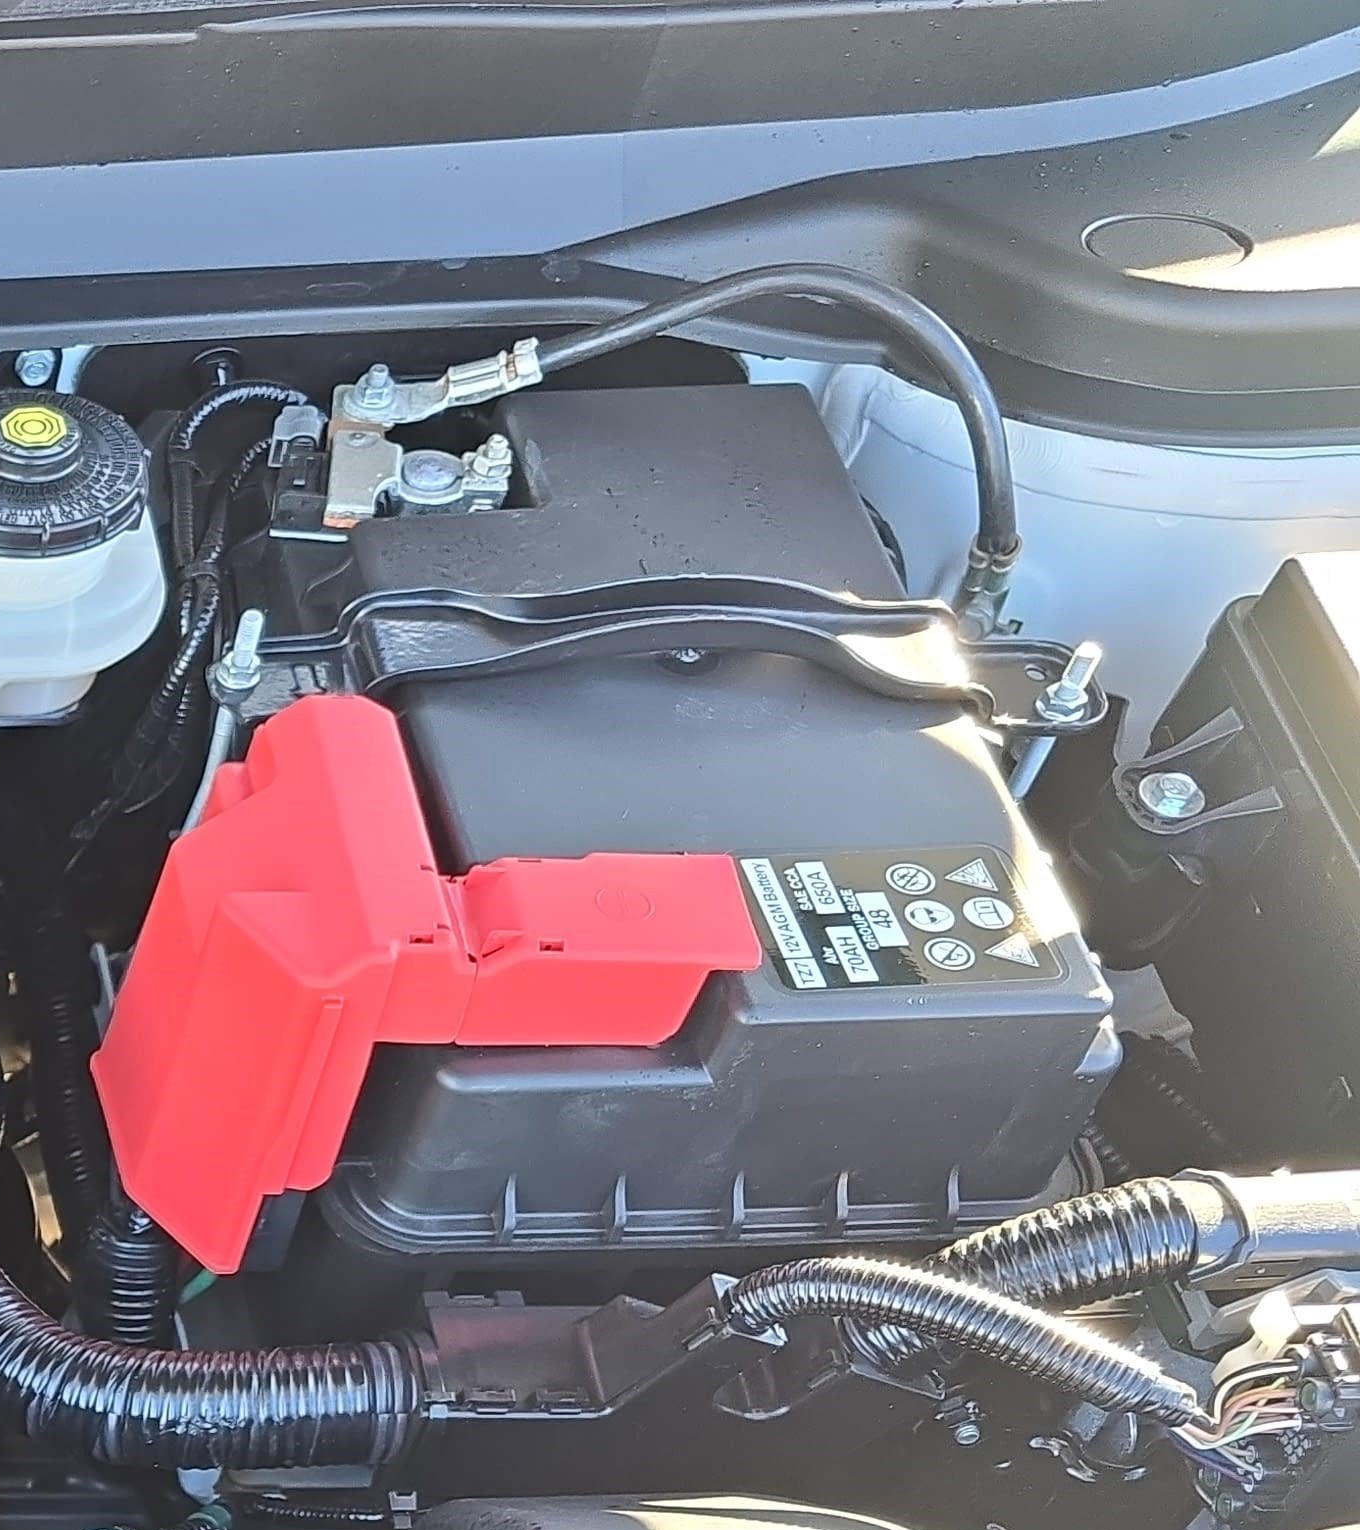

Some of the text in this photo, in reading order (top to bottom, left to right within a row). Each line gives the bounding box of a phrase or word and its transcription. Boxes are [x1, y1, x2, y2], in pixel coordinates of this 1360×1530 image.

[751, 862, 779, 901] Battery
[783, 867, 814, 911] SAE CCA
[807, 871, 836, 905] 650A
[839, 887, 881, 951] GROUP SIZE
[868, 909, 894, 929] 48
[793, 962, 815, 984] TZ7
[836, 936, 869, 974] 70AH
